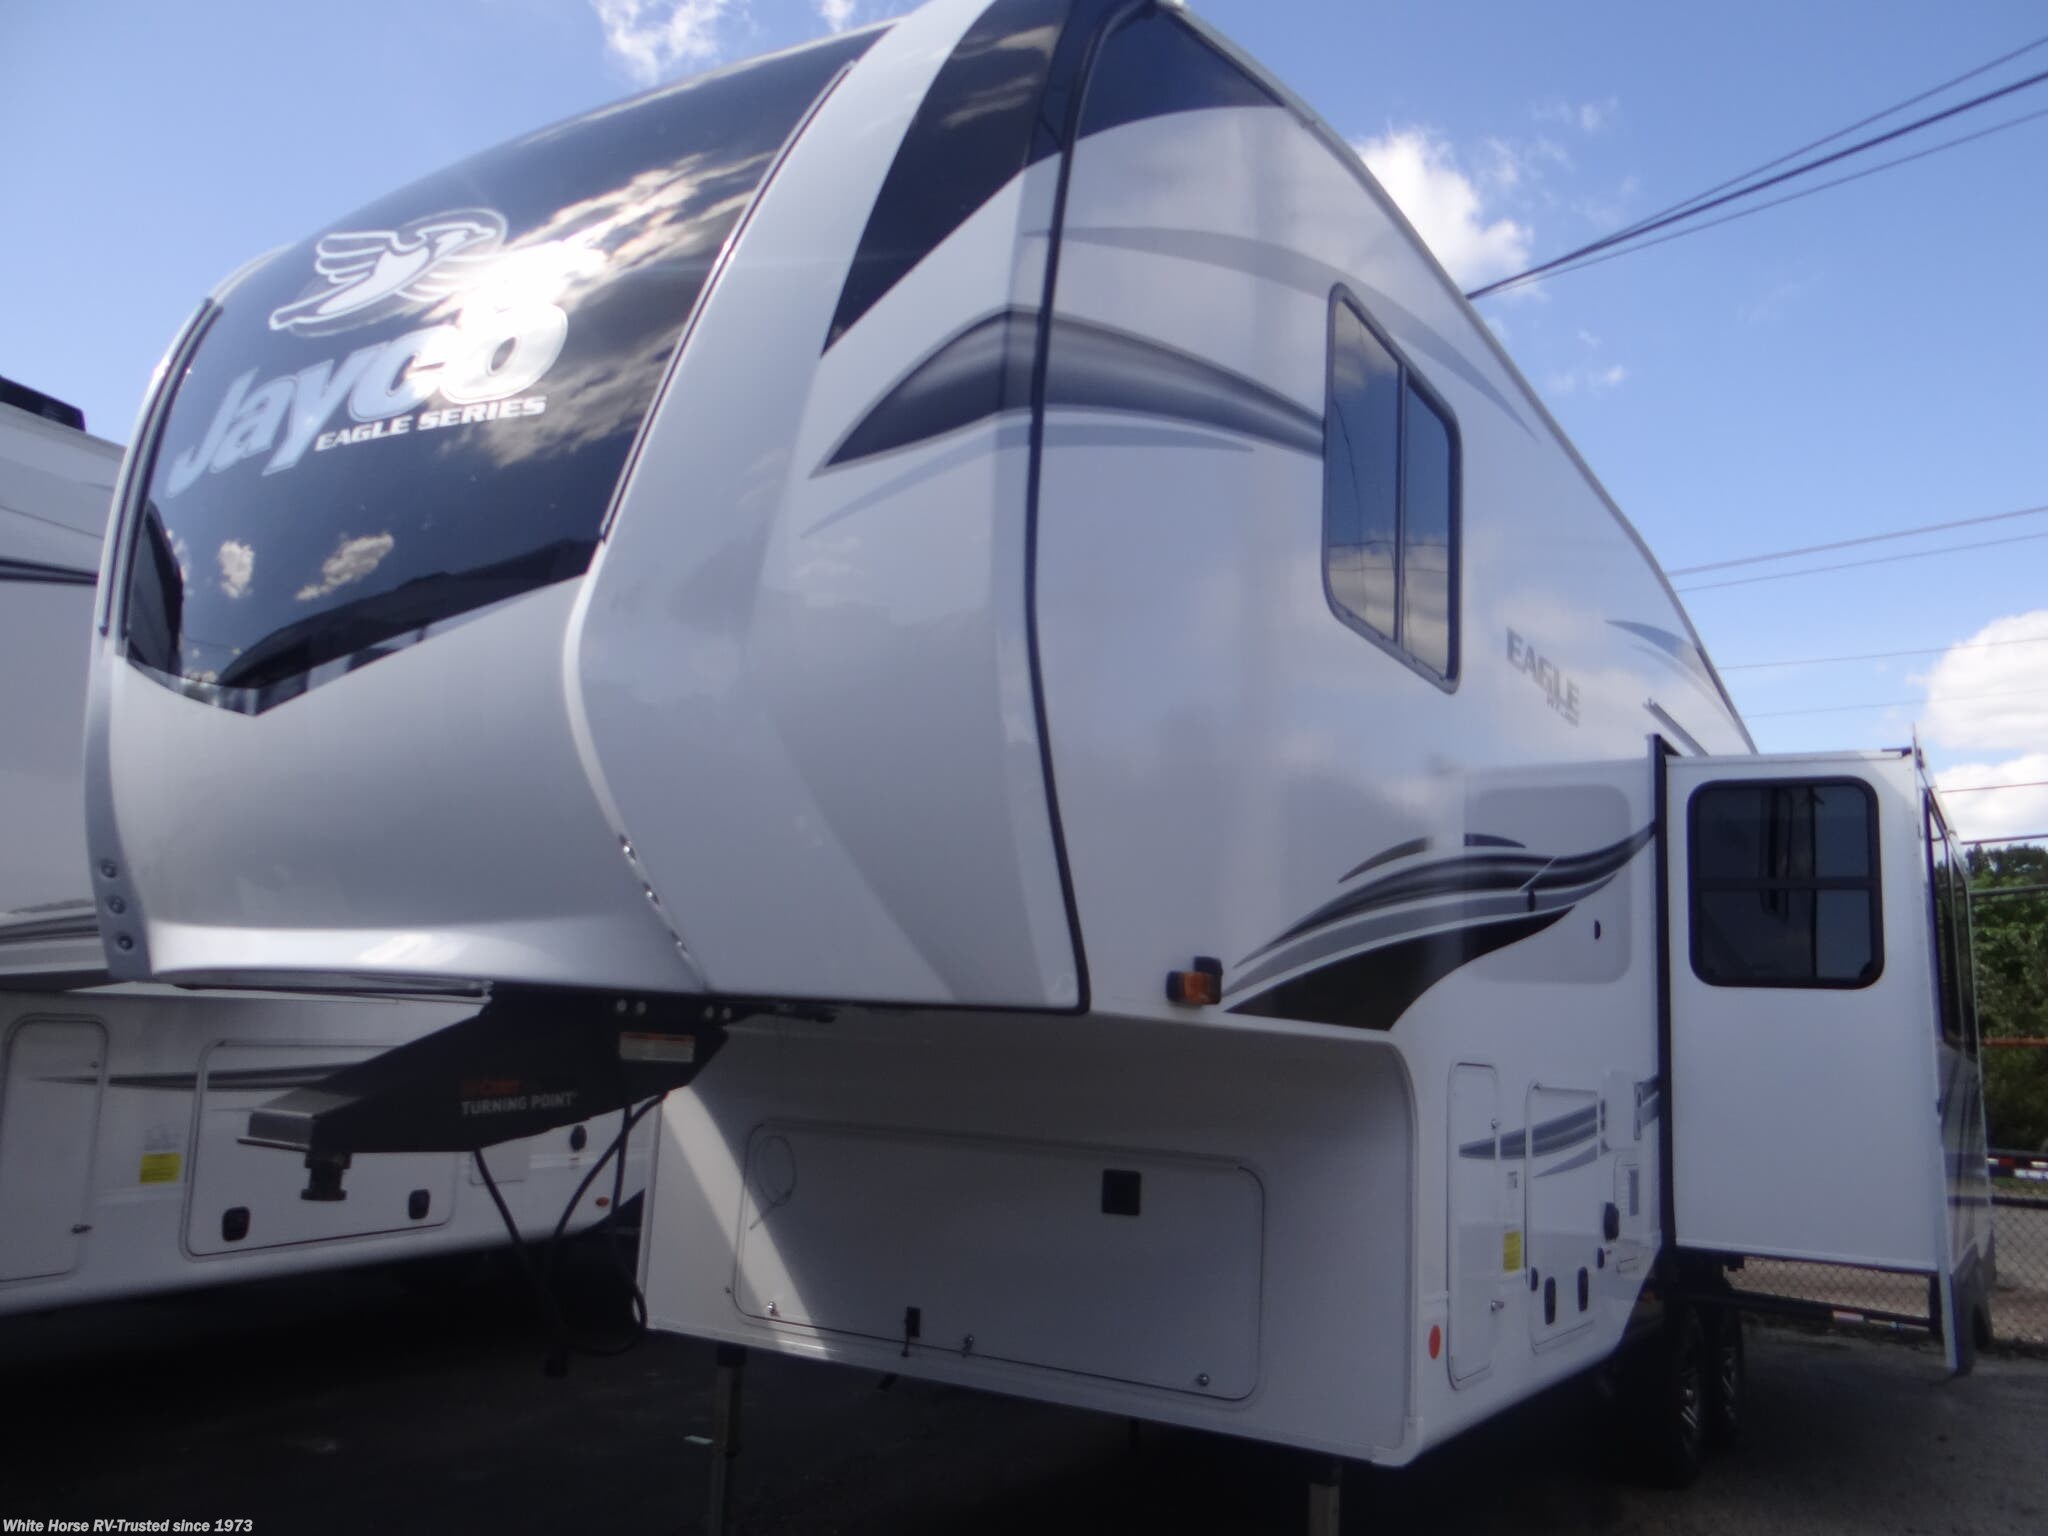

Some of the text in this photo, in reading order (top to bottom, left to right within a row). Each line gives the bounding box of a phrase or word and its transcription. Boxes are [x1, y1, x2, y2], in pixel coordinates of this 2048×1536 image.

[315, 395, 547, 451] EAGLE SERIES
[1505, 626, 1580, 716] EAGLE
[461, 1091, 574, 1116] TURNING POINT
